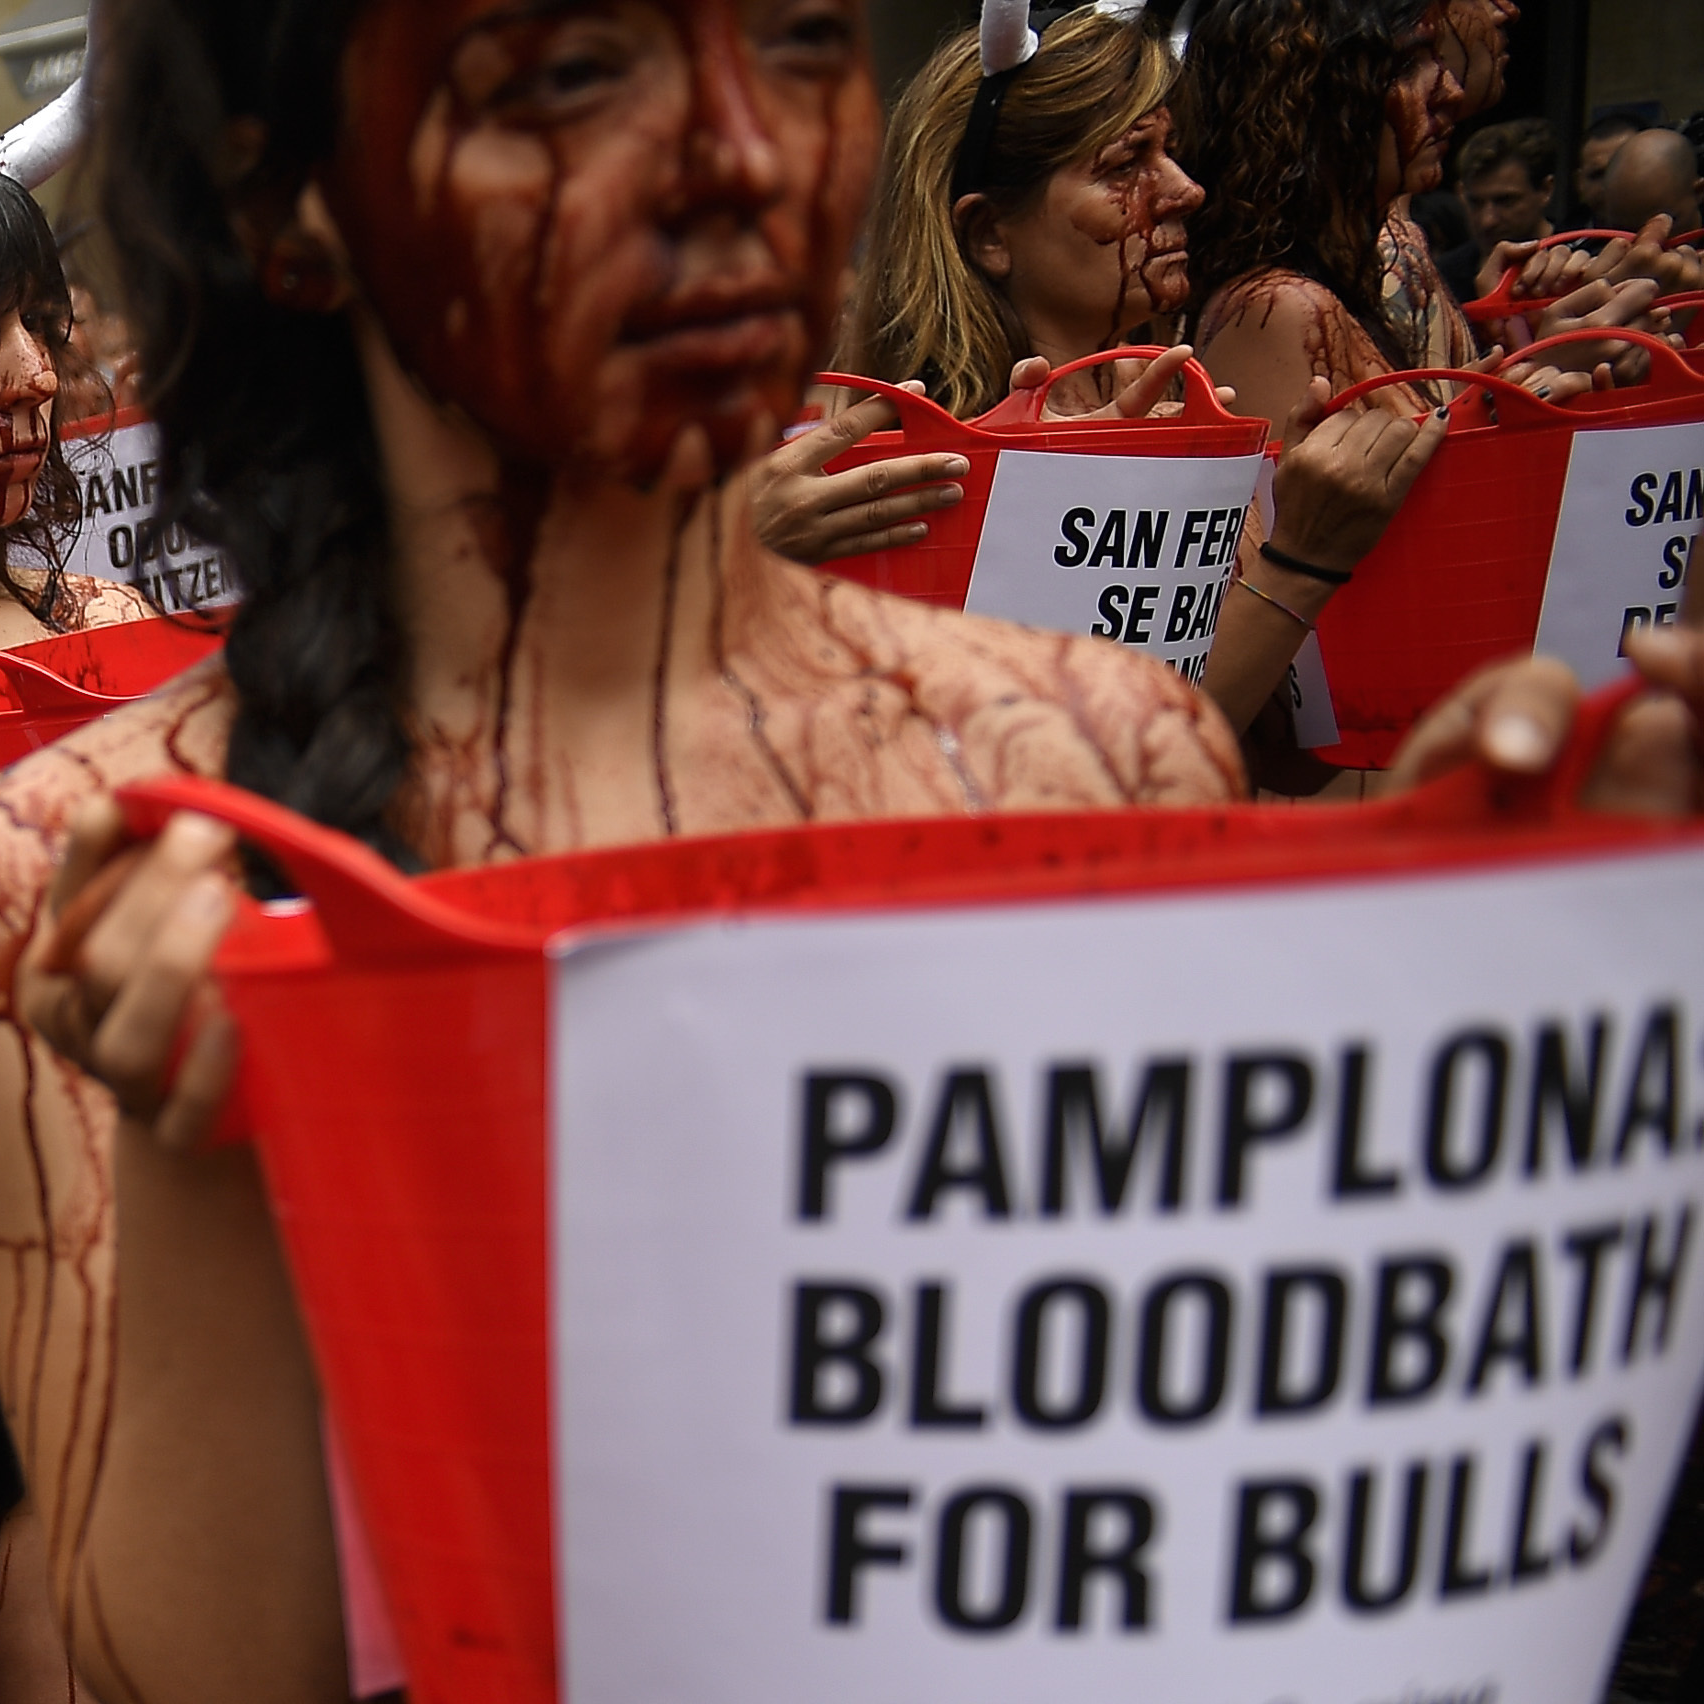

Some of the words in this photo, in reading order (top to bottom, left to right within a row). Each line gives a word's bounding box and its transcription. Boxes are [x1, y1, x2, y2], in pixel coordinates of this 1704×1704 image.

[1053, 506, 1170, 569] SAN
[1173, 504, 1249, 569] FER
[1090, 584, 1160, 644] SE
[785, 1205, 1695, 1430] BLOODBATH
[821, 1480, 1161, 1640] FOR
[1223, 1415, 1633, 1628] BULLS
